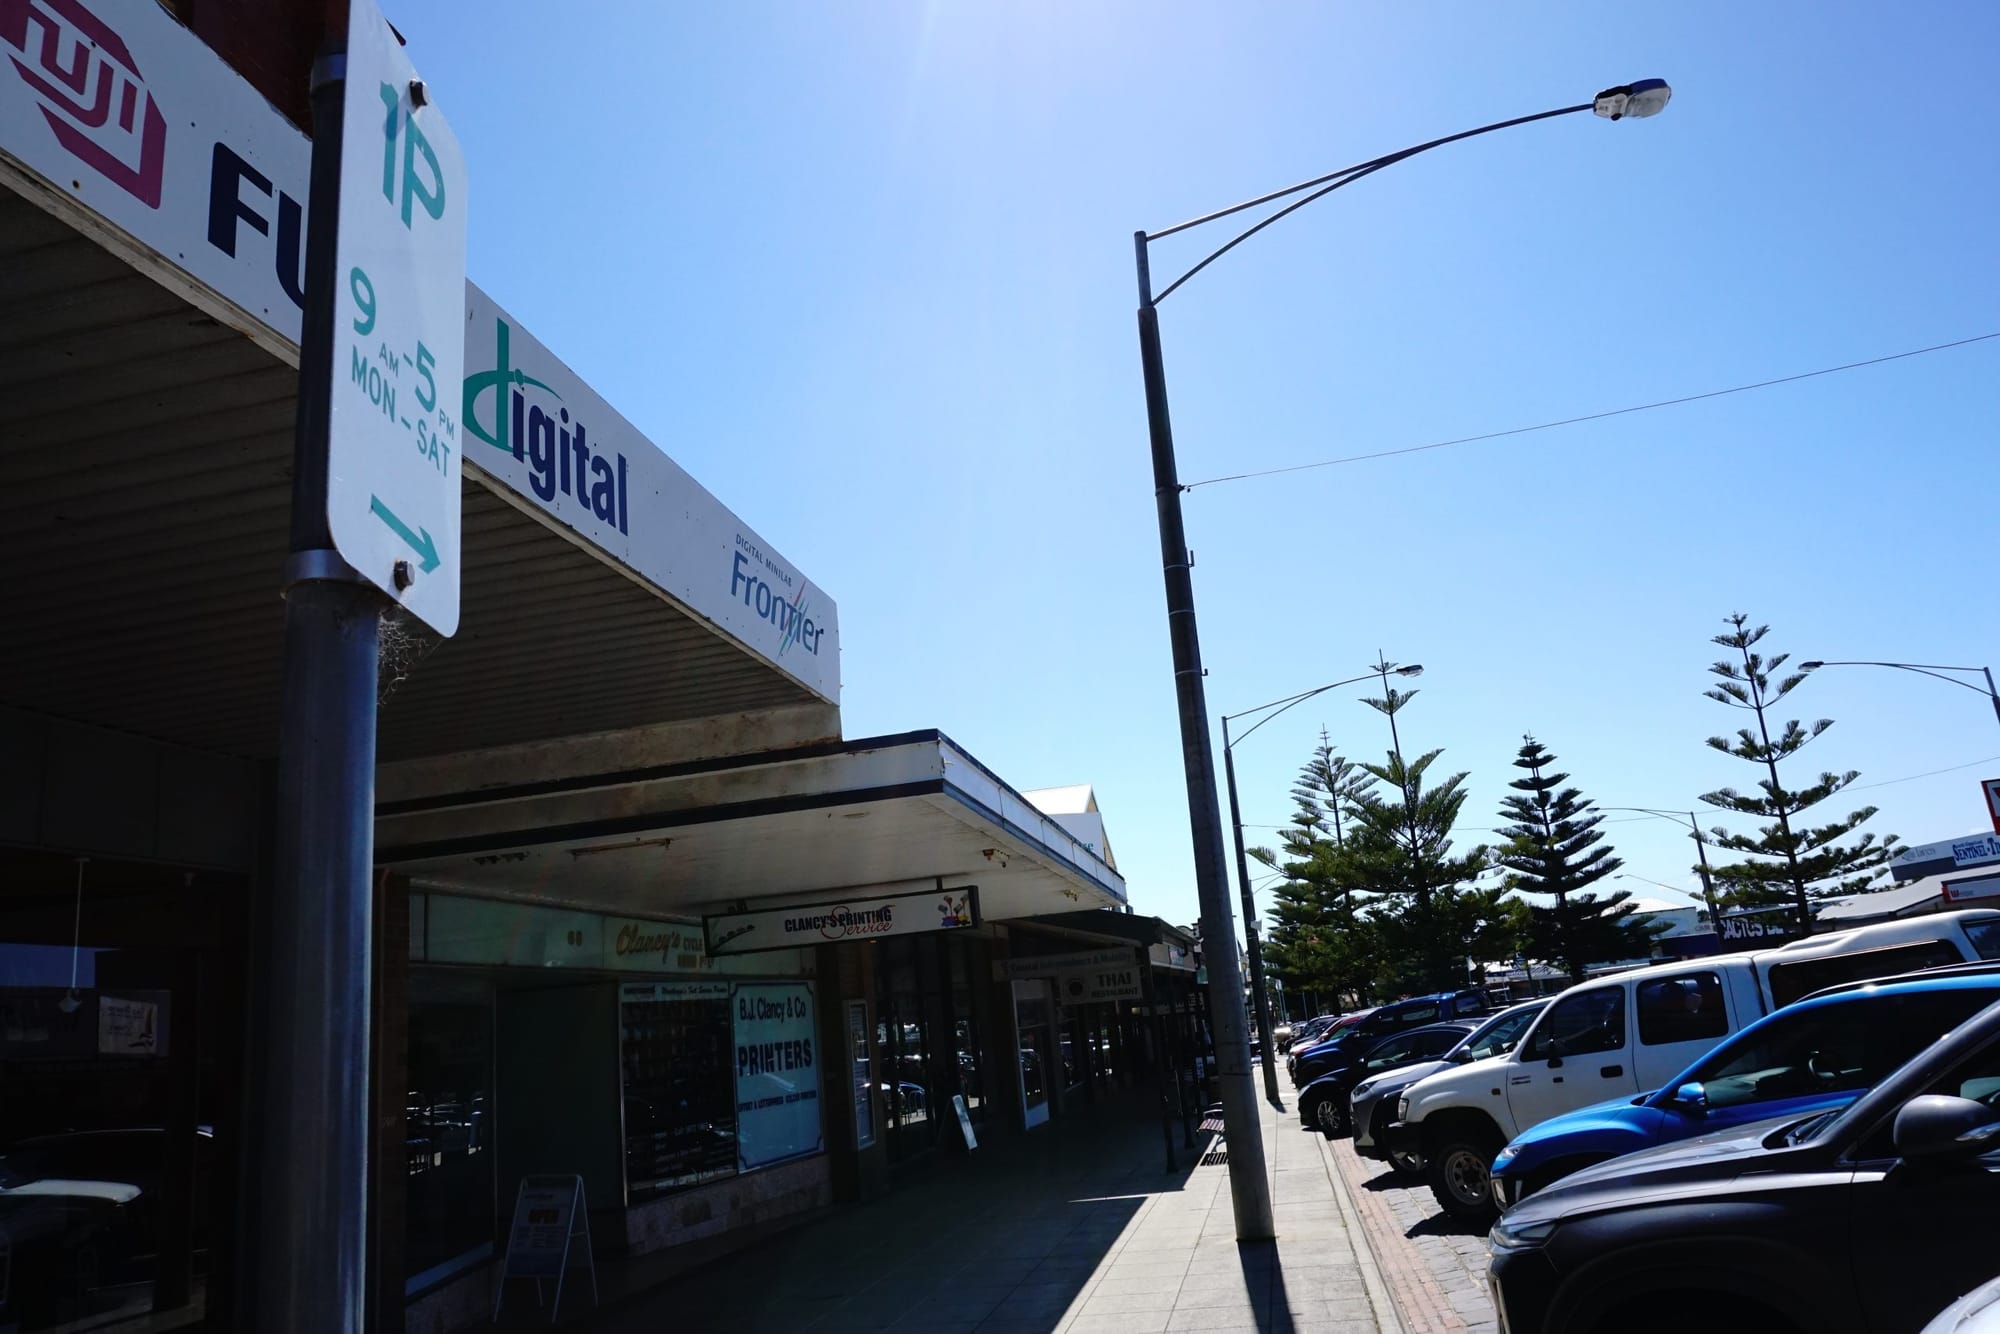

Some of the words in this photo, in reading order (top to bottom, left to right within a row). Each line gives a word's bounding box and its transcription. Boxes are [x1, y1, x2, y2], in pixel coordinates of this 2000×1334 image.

[380, 80, 446, 231] 1P
[462, 317, 629, 537] digital
[735, 533, 764, 564] DIGITAL
[765, 558, 793, 588] MINILAB
[836, 909, 893, 927] PRINTING
[1096, 971, 1132, 987] THAI
[757, 997, 785, 1023] Clancy
[786, 997, 793, 1016] &
[794, 996, 807, 1018] Co
[738, 1038, 812, 1076] PRINTERS
